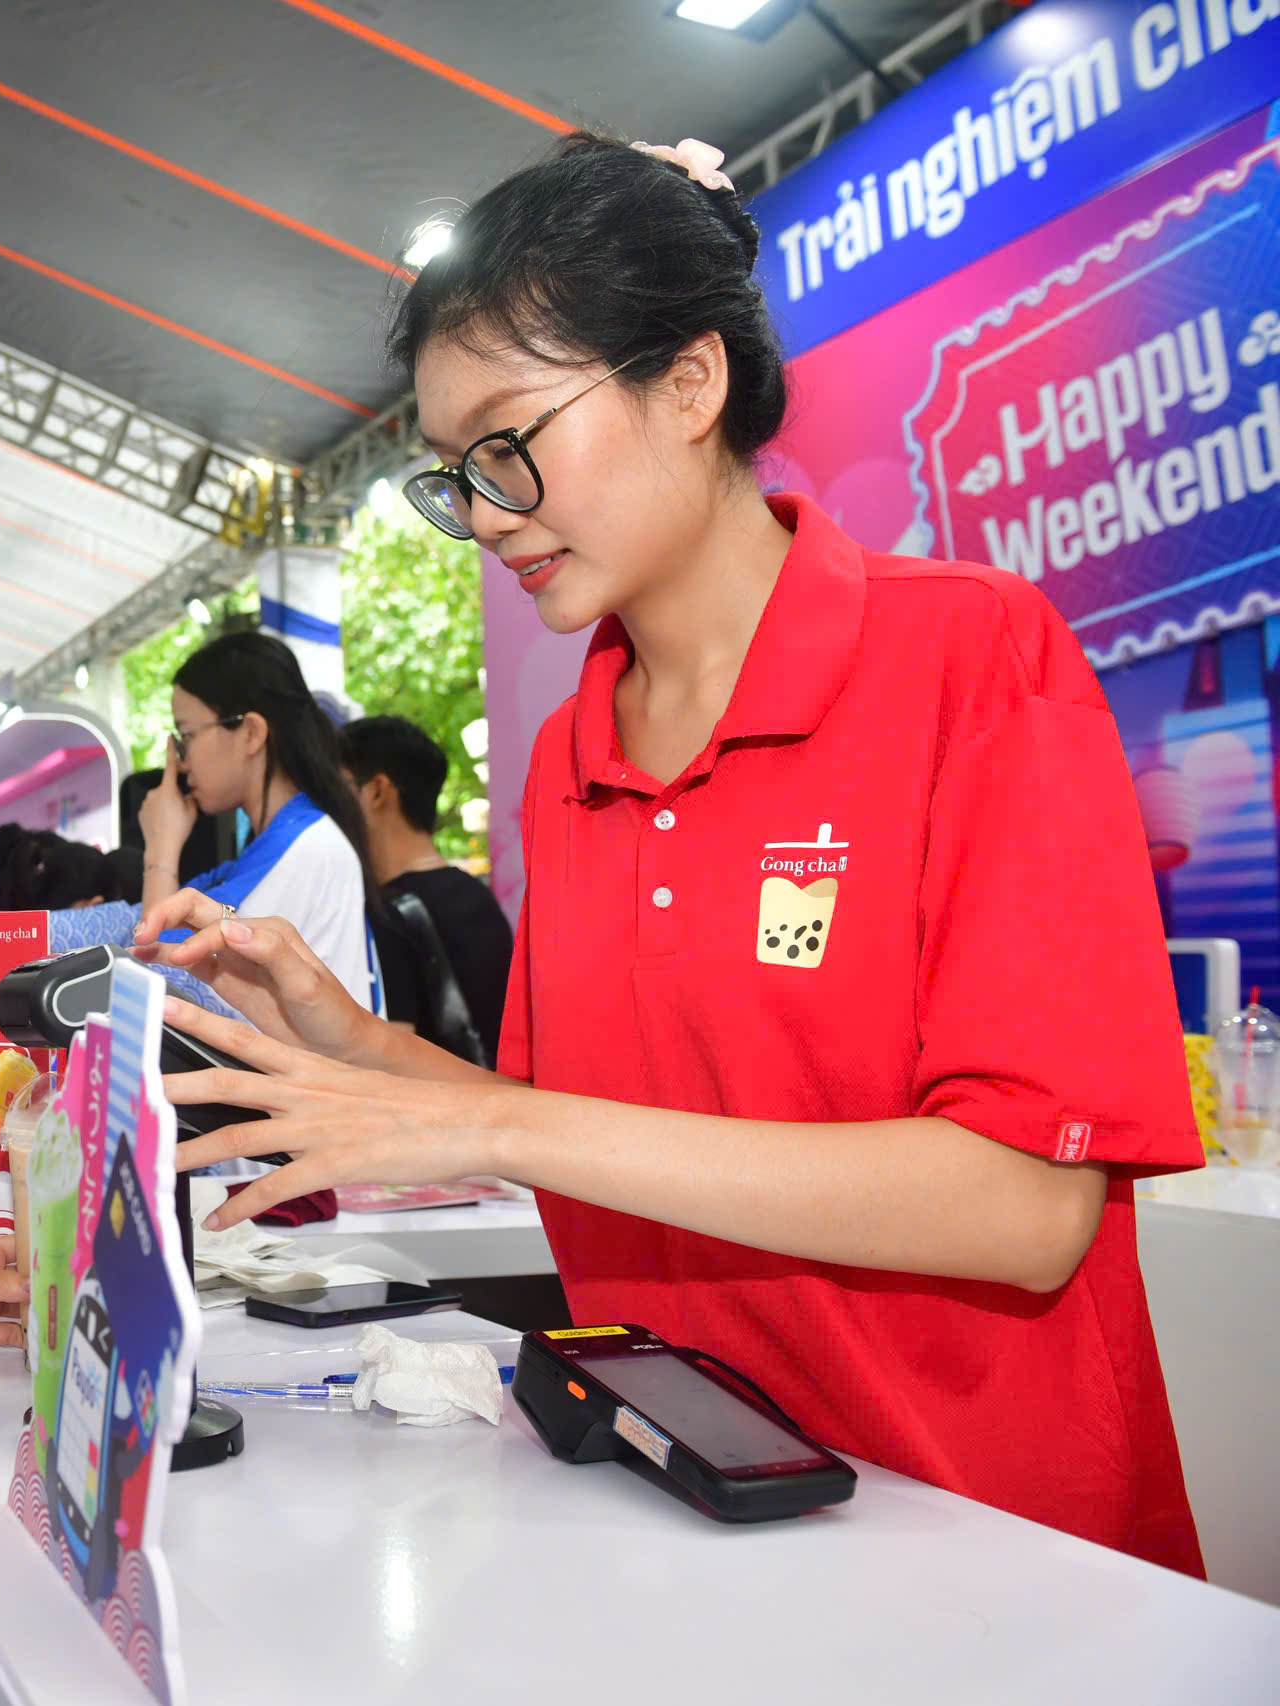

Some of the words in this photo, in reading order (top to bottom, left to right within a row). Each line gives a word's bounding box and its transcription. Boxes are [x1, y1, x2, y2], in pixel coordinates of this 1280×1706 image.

[777, 174, 884, 303] Trải
[887, 37, 1122, 239] nghiệm
[1000, 307, 1231, 487] Happy
[13, 927, 32, 939] cha
[760, 856, 805, 877] Gong
[808, 856, 837, 872] cha
[81, 1042, 104, 1242] ようこそ
